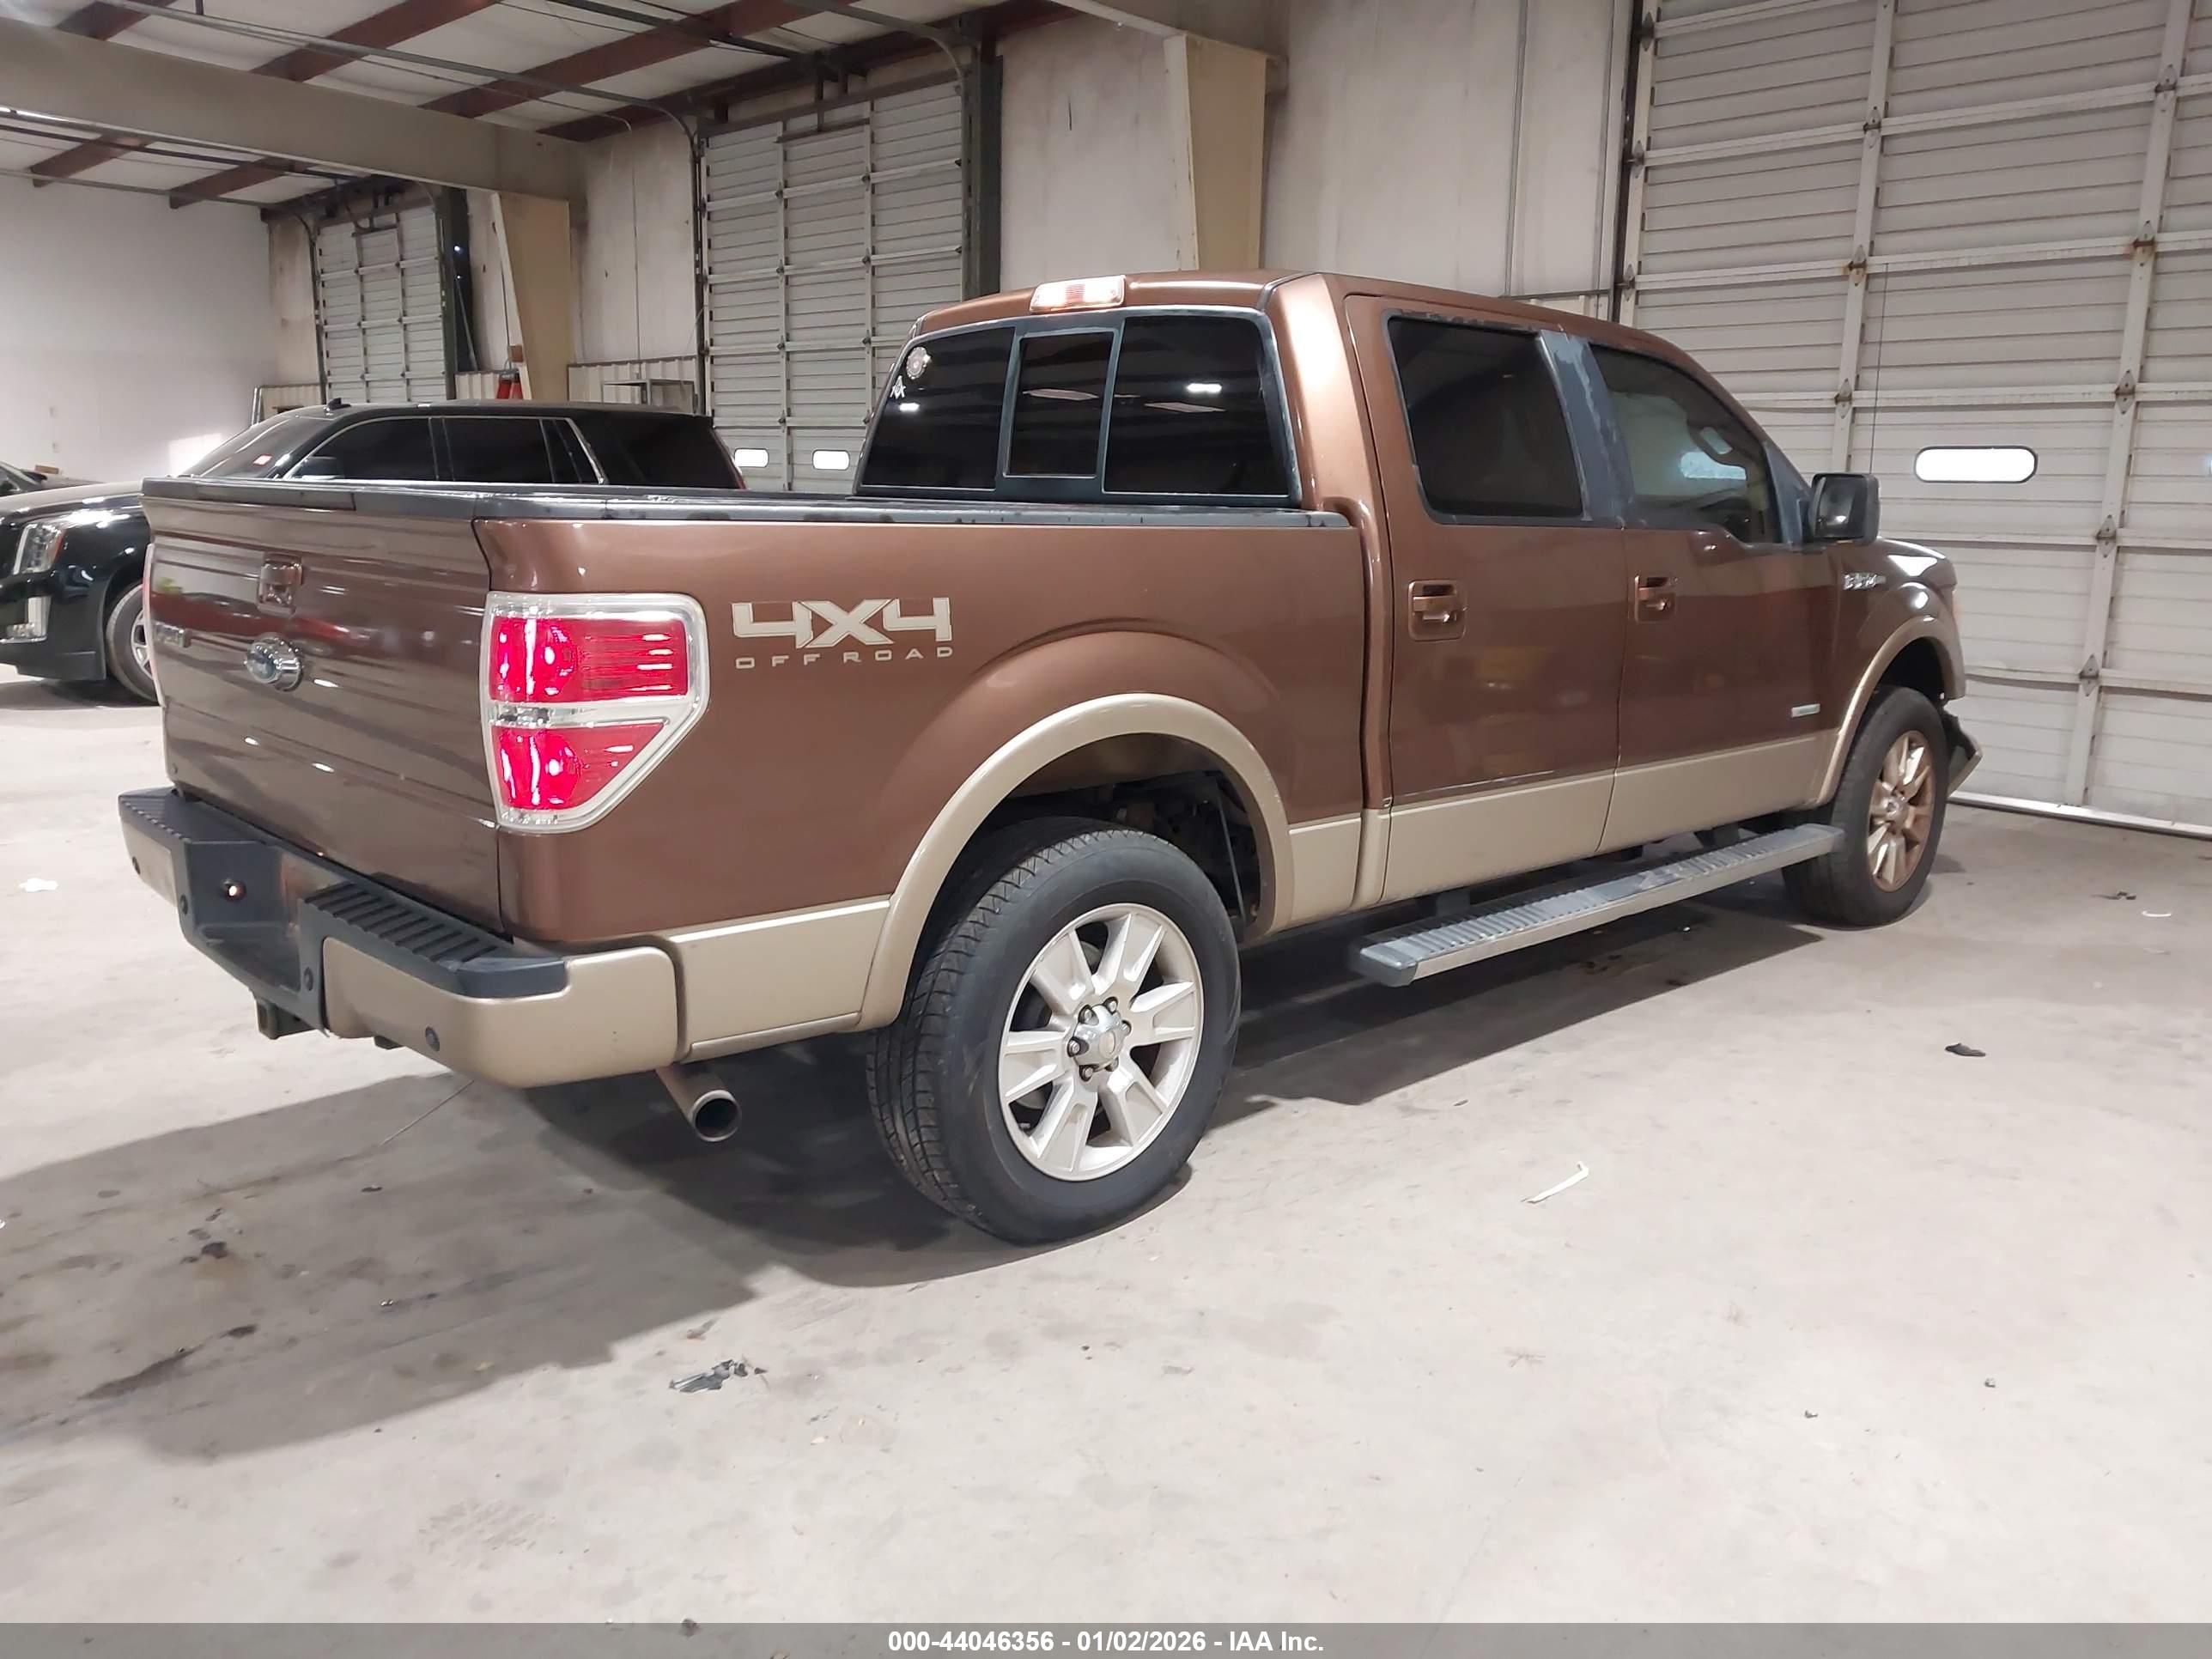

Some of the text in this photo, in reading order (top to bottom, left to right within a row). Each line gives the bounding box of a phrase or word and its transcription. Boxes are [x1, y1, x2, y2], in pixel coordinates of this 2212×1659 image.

[732, 597, 952, 649] 4X4
[735, 647, 953, 669] OFF ROAD
